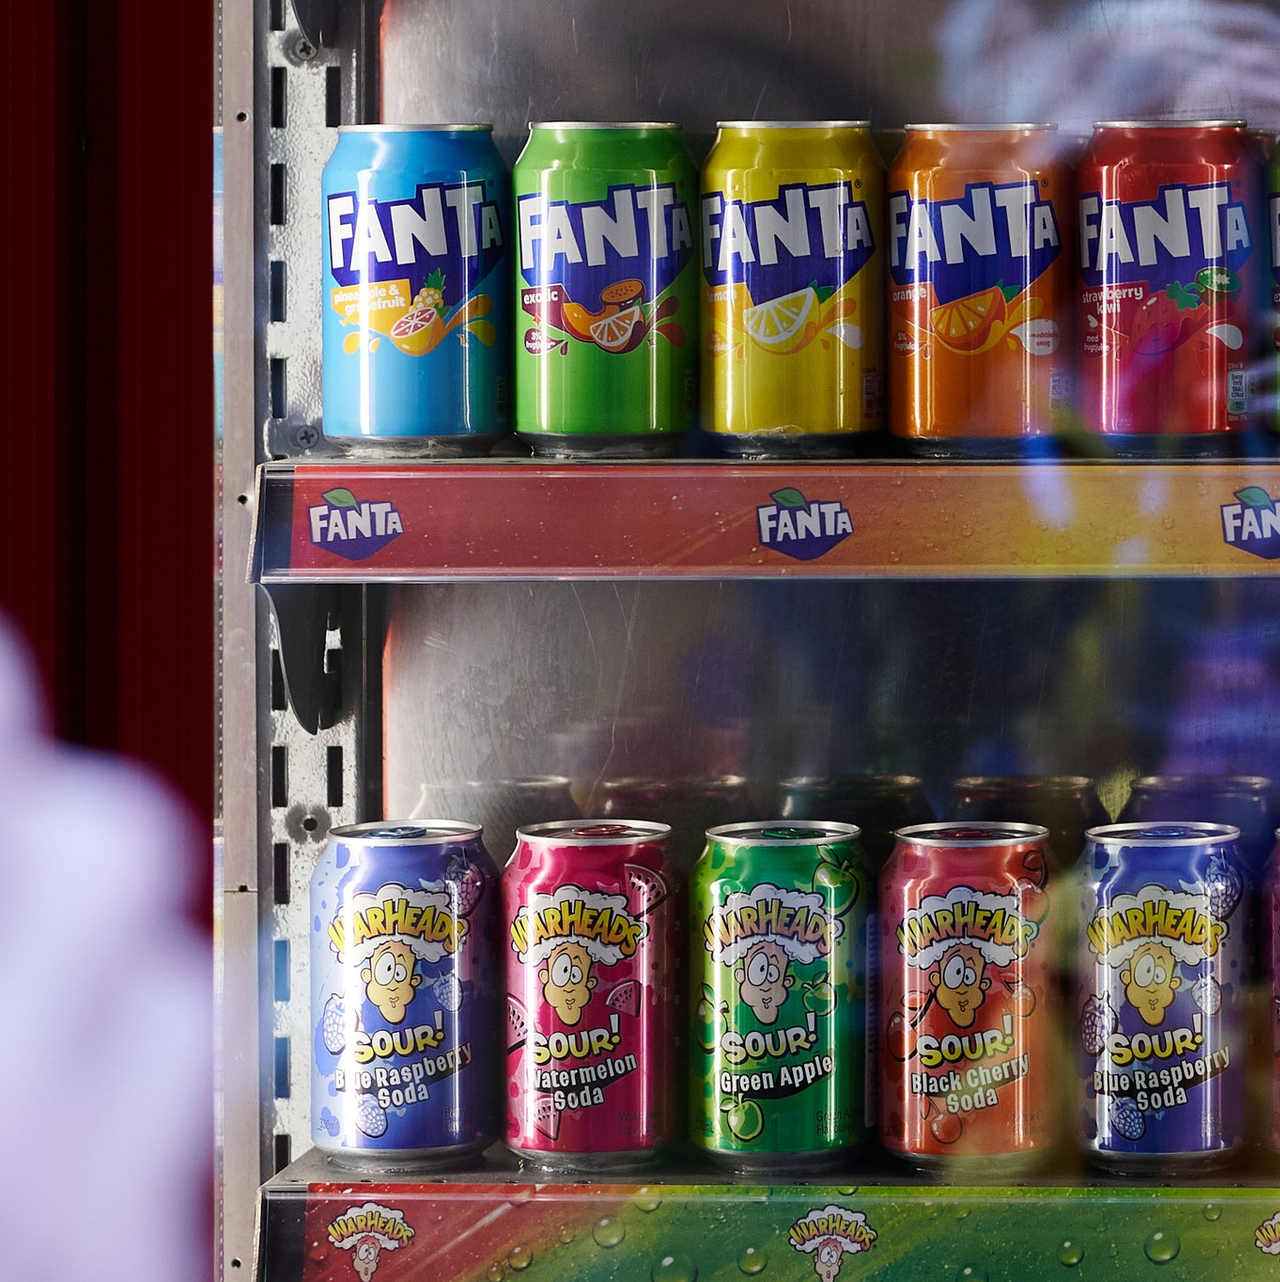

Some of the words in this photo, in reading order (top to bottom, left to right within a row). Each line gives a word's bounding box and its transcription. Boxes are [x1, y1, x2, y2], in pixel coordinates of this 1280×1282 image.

[519, 187, 694, 272] FANTA
[703, 187, 872, 272] FANTA
[892, 185, 1059, 270] FANTA
[1080, 186, 1250, 272] FANTA
[893, 287, 927, 302] orange
[1082, 288, 1144, 305] strawberry
[309, 503, 404, 544] FANTA
[760, 502, 853, 543] FANTA
[897, 901, 1036, 955] WARHEADS
[1088, 901, 1222, 954] WARHEADS
[353, 1011, 445, 1063] SOUR!
[527, 1014, 620, 1064] SOUR!
[723, 1012, 817, 1064] SOUR!
[916, 1015, 1014, 1065] SOUR!
[1111, 1015, 1205, 1065] SOUR!
[378, 1082, 429, 1111] Soda
[721, 1065, 774, 1094] Green
[780, 1057, 833, 1090] Apple
[911, 1067, 961, 1093] Black
[966, 1053, 1029, 1087] Cherry
[554, 1087, 604, 1112] Soda
[947, 1089, 999, 1114] Soda
[1136, 1087, 1188, 1112] Soda
